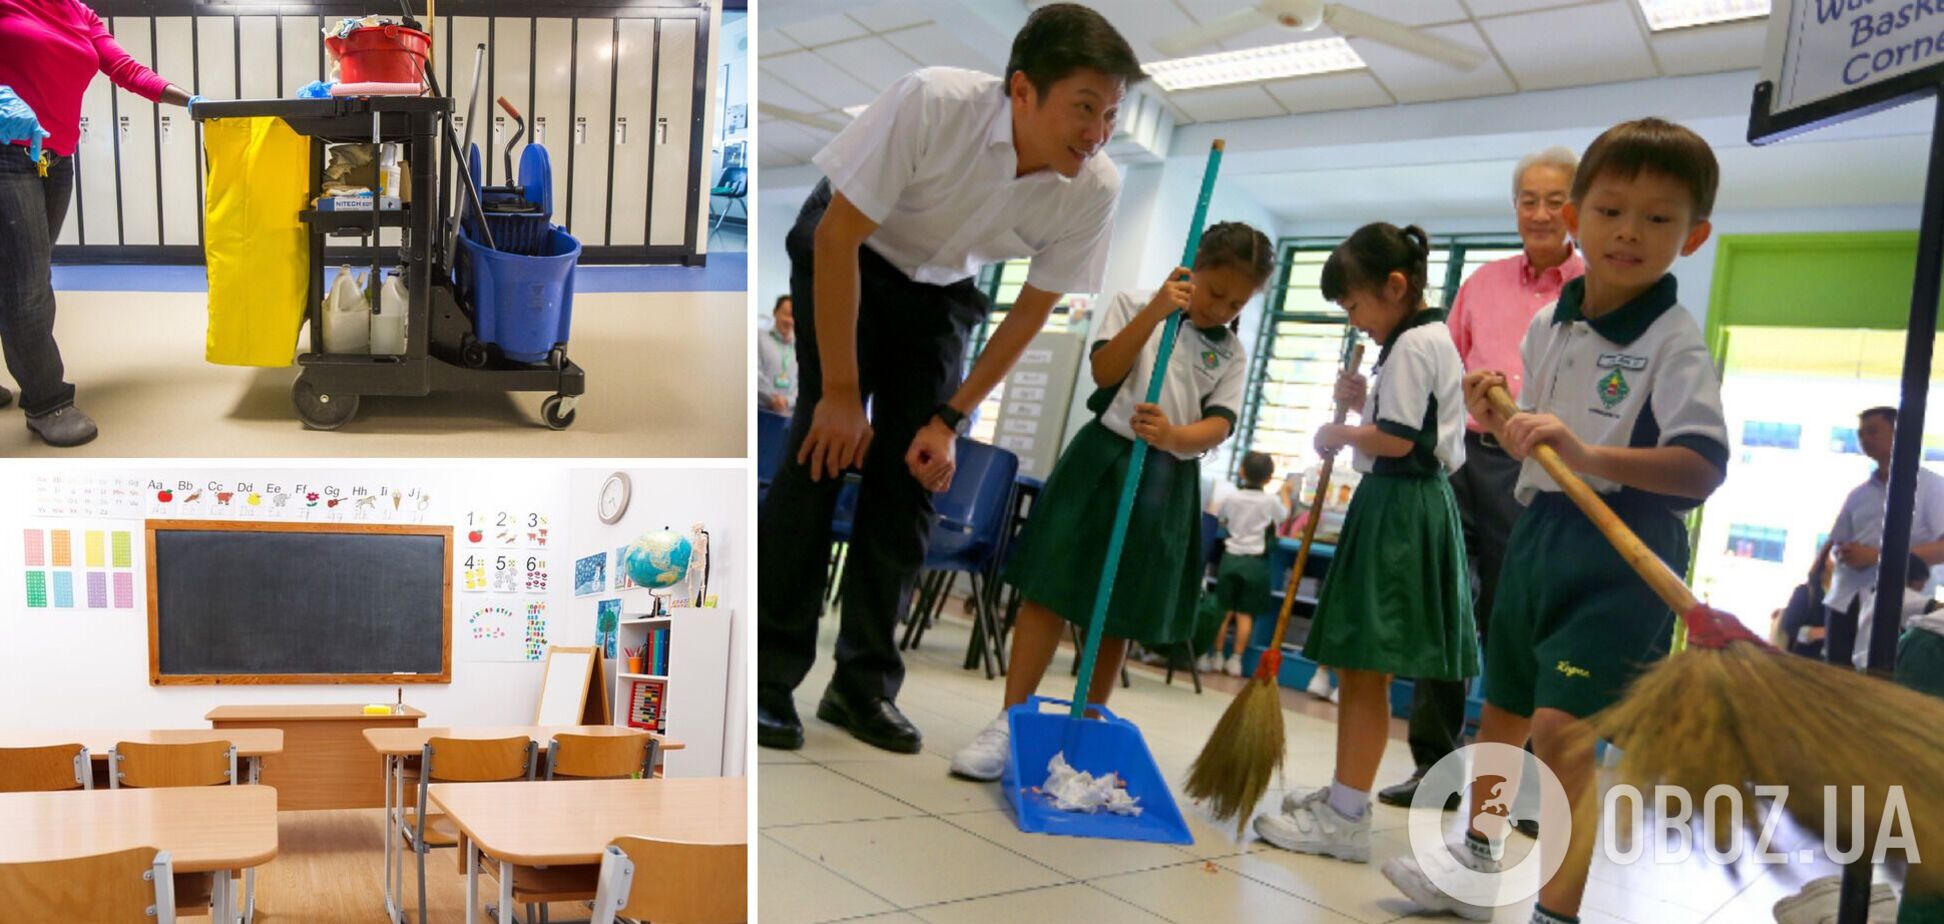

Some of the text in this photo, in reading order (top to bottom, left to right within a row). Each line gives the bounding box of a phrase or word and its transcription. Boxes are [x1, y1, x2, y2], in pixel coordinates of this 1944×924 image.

[147, 479, 163, 490] Aa
[178, 480, 194, 491] Bb
[207, 481, 223, 492] Cc
[237, 482, 253, 493] Dd
[266, 483, 282, 494] Ee
[295, 484, 308, 494] Ff
[324, 485, 340, 497] Gg
[352, 486, 368, 497] Hh
[380, 486, 388, 497] Ii
[467, 511, 538, 528] 1 2 3
[464, 554, 537, 571] 4 5 6
